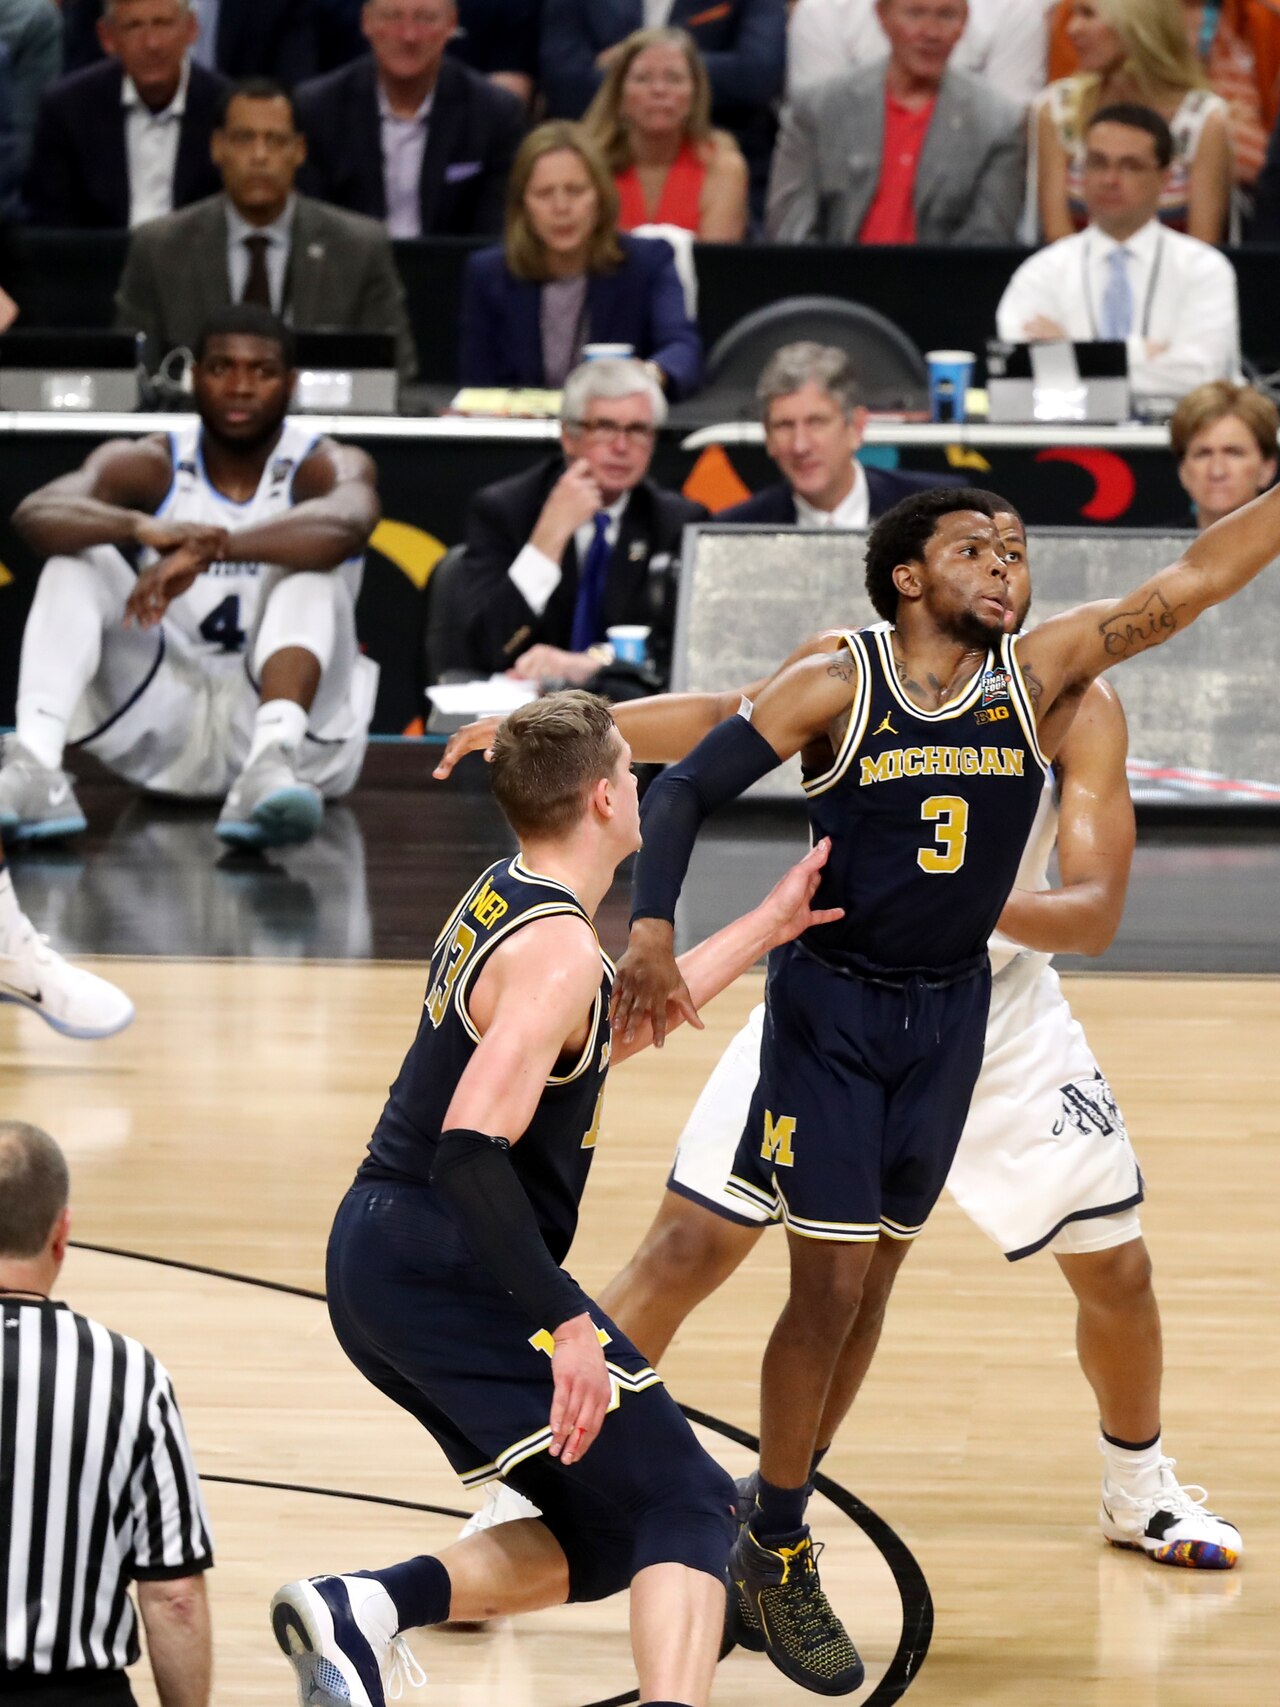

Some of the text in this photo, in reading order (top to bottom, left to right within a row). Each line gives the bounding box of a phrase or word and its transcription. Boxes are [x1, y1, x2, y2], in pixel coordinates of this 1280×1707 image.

[200, 595, 246, 655] 4
[982, 673, 1005, 688] FINAL
[985, 681, 1007, 693] FOUR
[860, 747, 1024, 786] MICHIGAN
[917, 795, 969, 873] 3
[760, 1108, 797, 1168] M
